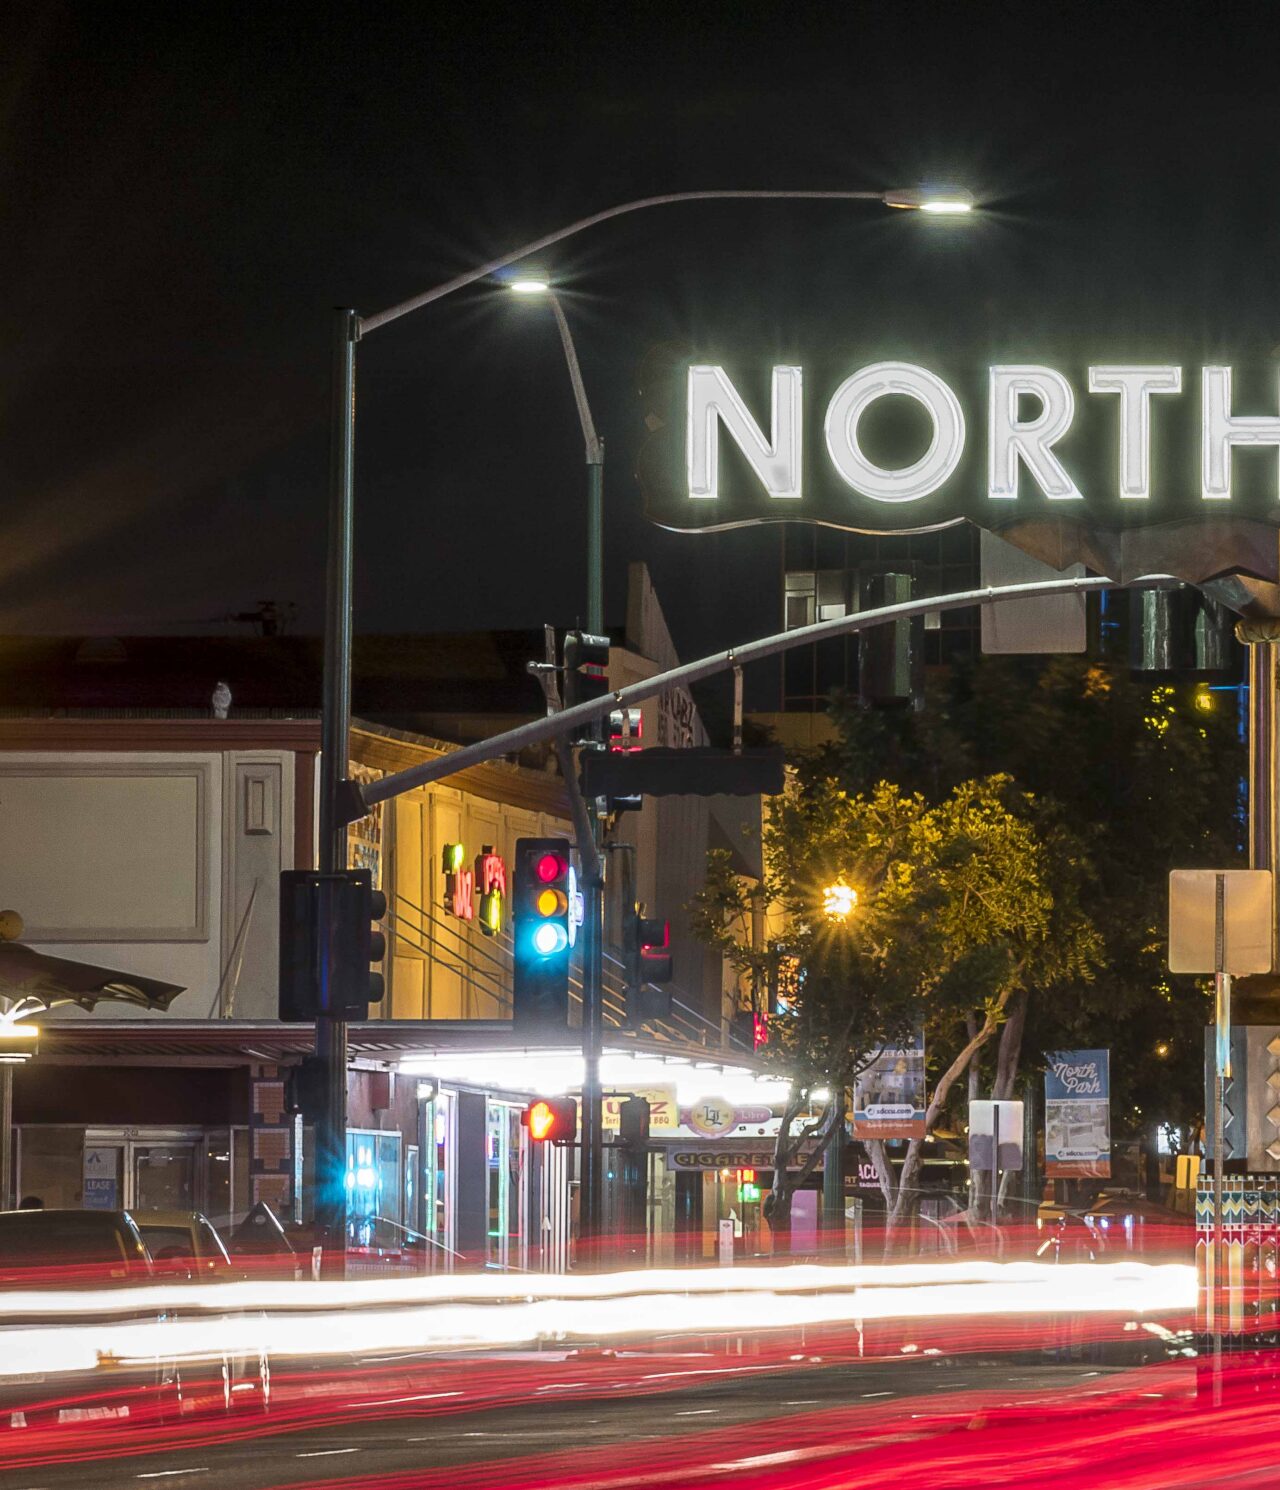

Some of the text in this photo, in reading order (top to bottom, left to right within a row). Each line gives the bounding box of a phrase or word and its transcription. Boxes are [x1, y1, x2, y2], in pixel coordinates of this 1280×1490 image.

[1053, 1062, 1098, 1080] North
[1066, 1077, 1101, 1094] Park
[605, 1116, 670, 1125] Teri BBQ
[741, 1110, 765, 1119] Libre
[676, 1152, 825, 1167] CIGARETE
[87, 1180, 111, 1190] LEASE
